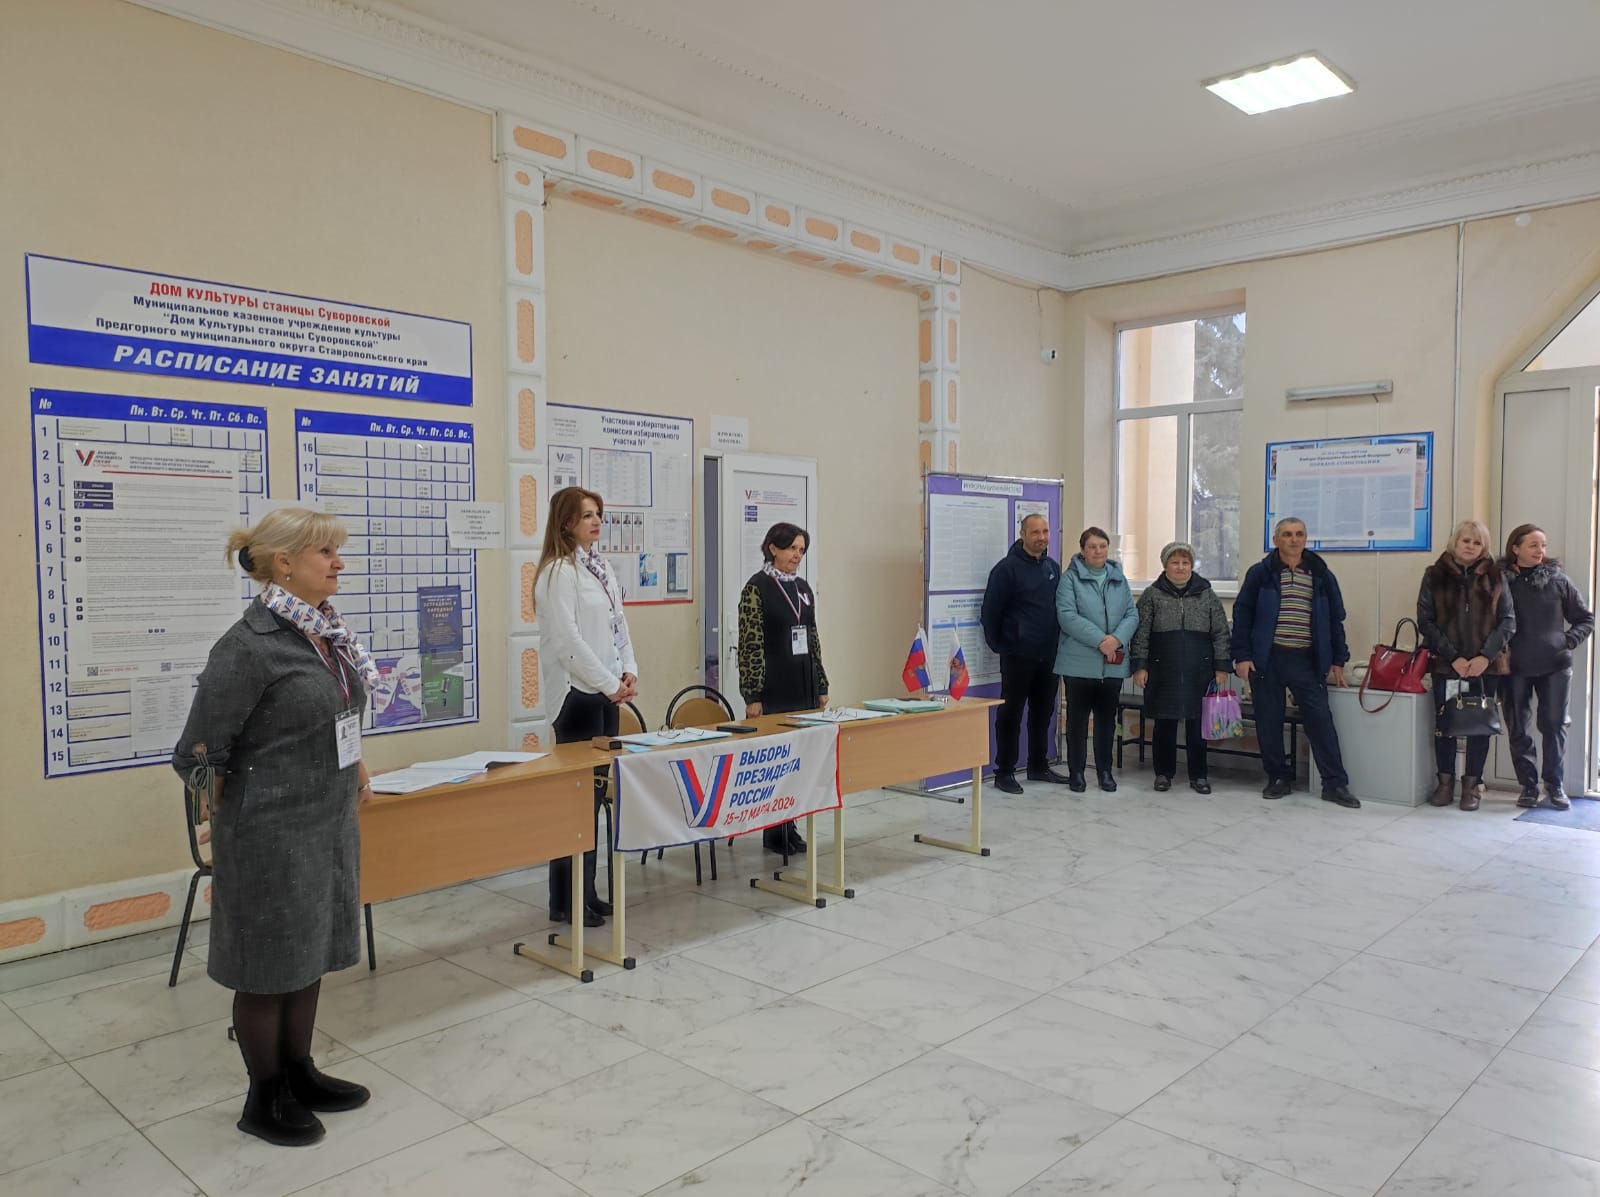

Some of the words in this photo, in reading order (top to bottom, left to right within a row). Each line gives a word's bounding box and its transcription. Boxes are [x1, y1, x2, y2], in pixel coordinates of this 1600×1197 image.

[150, 282, 182, 297] ДОМ
[187, 287, 258, 308] КУЛЬТУРЫ
[262, 301, 315, 317] станицы
[318, 307, 391, 327] Суворовской
[133, 296, 229, 318] Муниципальное
[233, 311, 284, 325] казенное
[288, 318, 351, 335] учреждение
[354, 328, 401, 342] культуры
[199, 318, 254, 334] Культуры
[258, 327, 305, 341] станицы
[96, 317, 177, 336] Предгорного
[180, 329, 276, 350] муниципального
[279, 341, 315, 353] округа
[318, 345, 404, 364] Ставропольского
[406, 358, 428, 368] края
[113, 345, 302, 382] РАСПИСАНИЕ
[309, 367, 420, 395] ЗАНЯТИЙ
[38, 397, 53, 410] №
[129, 404, 148, 417] Пн.
[151, 406, 168, 418] Вт.
[170, 408, 188, 421] Ср.
[191, 409, 207, 421] Чт.
[209, 410, 225, 422] Пт.
[227, 412, 244, 424] Сб.
[246, 414, 263, 425] Вс.
[601, 415, 636, 427] Участковая
[636, 420, 680, 431] избирательная
[41, 426, 48, 437] 1
[369, 422, 385, 433] Пн.
[386, 423, 399, 435] Вт.
[400, 424, 414, 437] Ср.
[416, 426, 429, 437] Чт.
[430, 426, 443, 438] Пт.
[444, 427, 457, 439] Сб.
[457, 429, 471, 440] Вс.
[602, 427, 633, 437] комиссия
[633, 429, 680, 441] избирательного
[612, 437, 637, 447] участка
[303, 443, 313, 453] 16
[42, 450, 50, 461] 2
[303, 463, 314, 473] 17
[43, 473, 51, 484] 3
[303, 483, 314, 493] 18
[43, 497, 51, 507] 4
[45, 519, 52, 530] 5
[46, 543, 53, 553] 6
[47, 566, 54, 577] 7
[47, 589, 55, 600] 8
[48, 612, 56, 623] 9
[48, 635, 61, 647] 10
[49, 659, 61, 670] 11
[49, 682, 62, 693] 12
[50, 705, 63, 716] 13
[51, 728, 64, 739] 14
[52, 750, 64, 761] 15
[739, 744, 791, 767] ВЫБОРЫ
[734, 757, 801, 788] ПРЕЗИДЕНТА
[729, 785, 776, 808] РОССИИ
[771, 796, 796, 813] 2024
